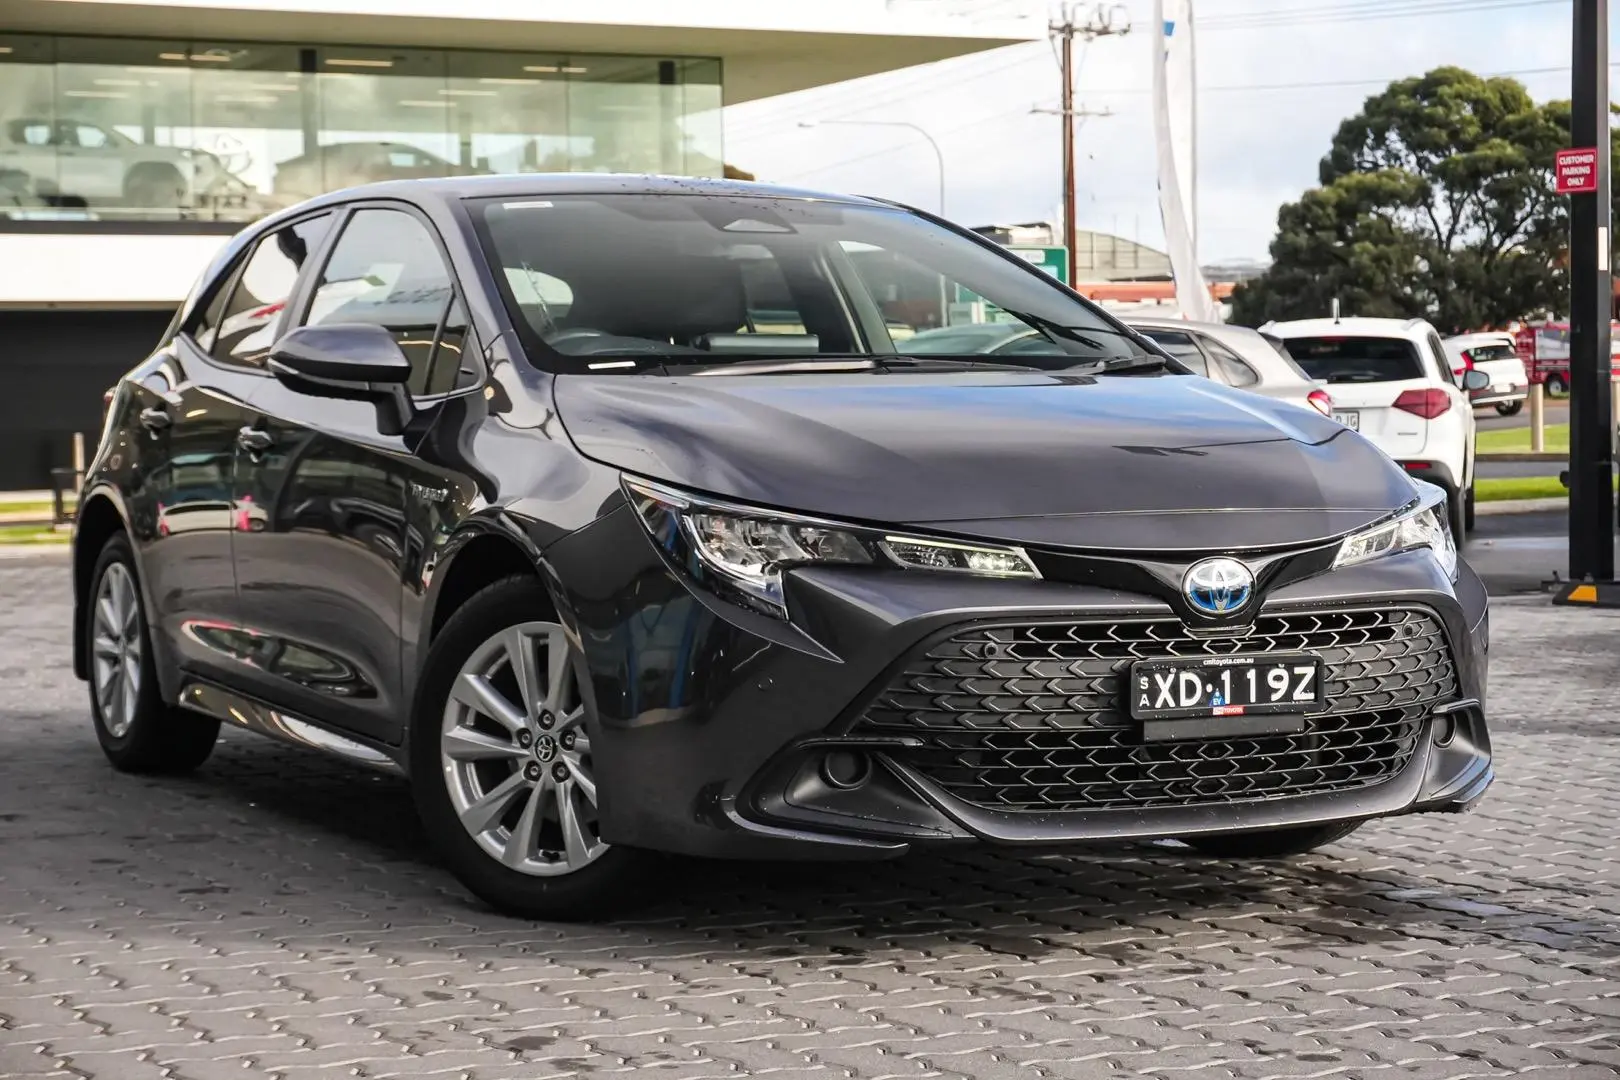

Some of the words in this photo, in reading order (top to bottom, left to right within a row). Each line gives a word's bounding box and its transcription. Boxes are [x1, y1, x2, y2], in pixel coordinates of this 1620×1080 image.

[1559, 154, 1594, 165] CUSTOMER
[1562, 165, 1591, 176] PARKING
[1567, 177, 1584, 186] ONLY
